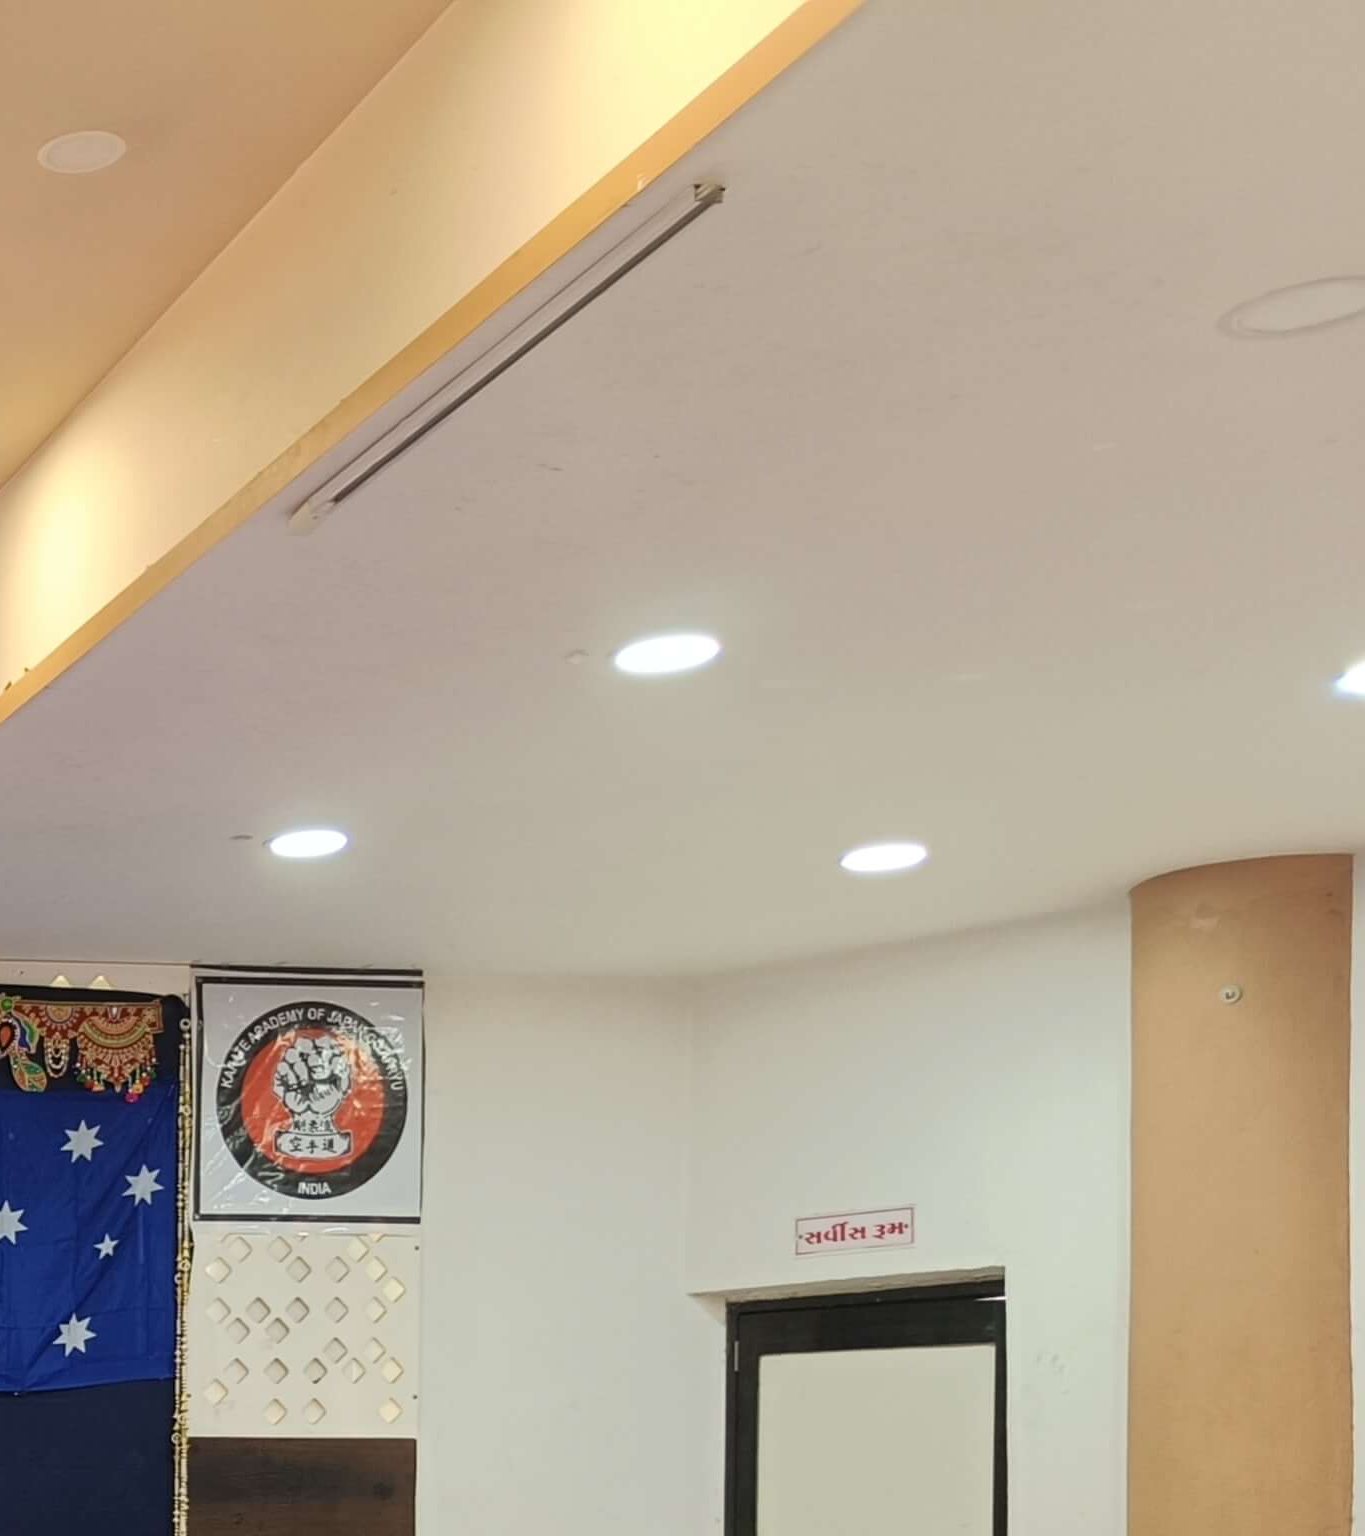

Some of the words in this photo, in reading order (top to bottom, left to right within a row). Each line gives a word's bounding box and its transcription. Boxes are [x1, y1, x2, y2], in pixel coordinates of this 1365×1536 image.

[247, 1008, 304, 1044] ACADEMY
[307, 1007, 326, 1021] OF
[298, 1181, 332, 1195] INDIA
[805, 1222, 866, 1245] સર્વીસ
[873, 1222, 904, 1239] રૂમ
